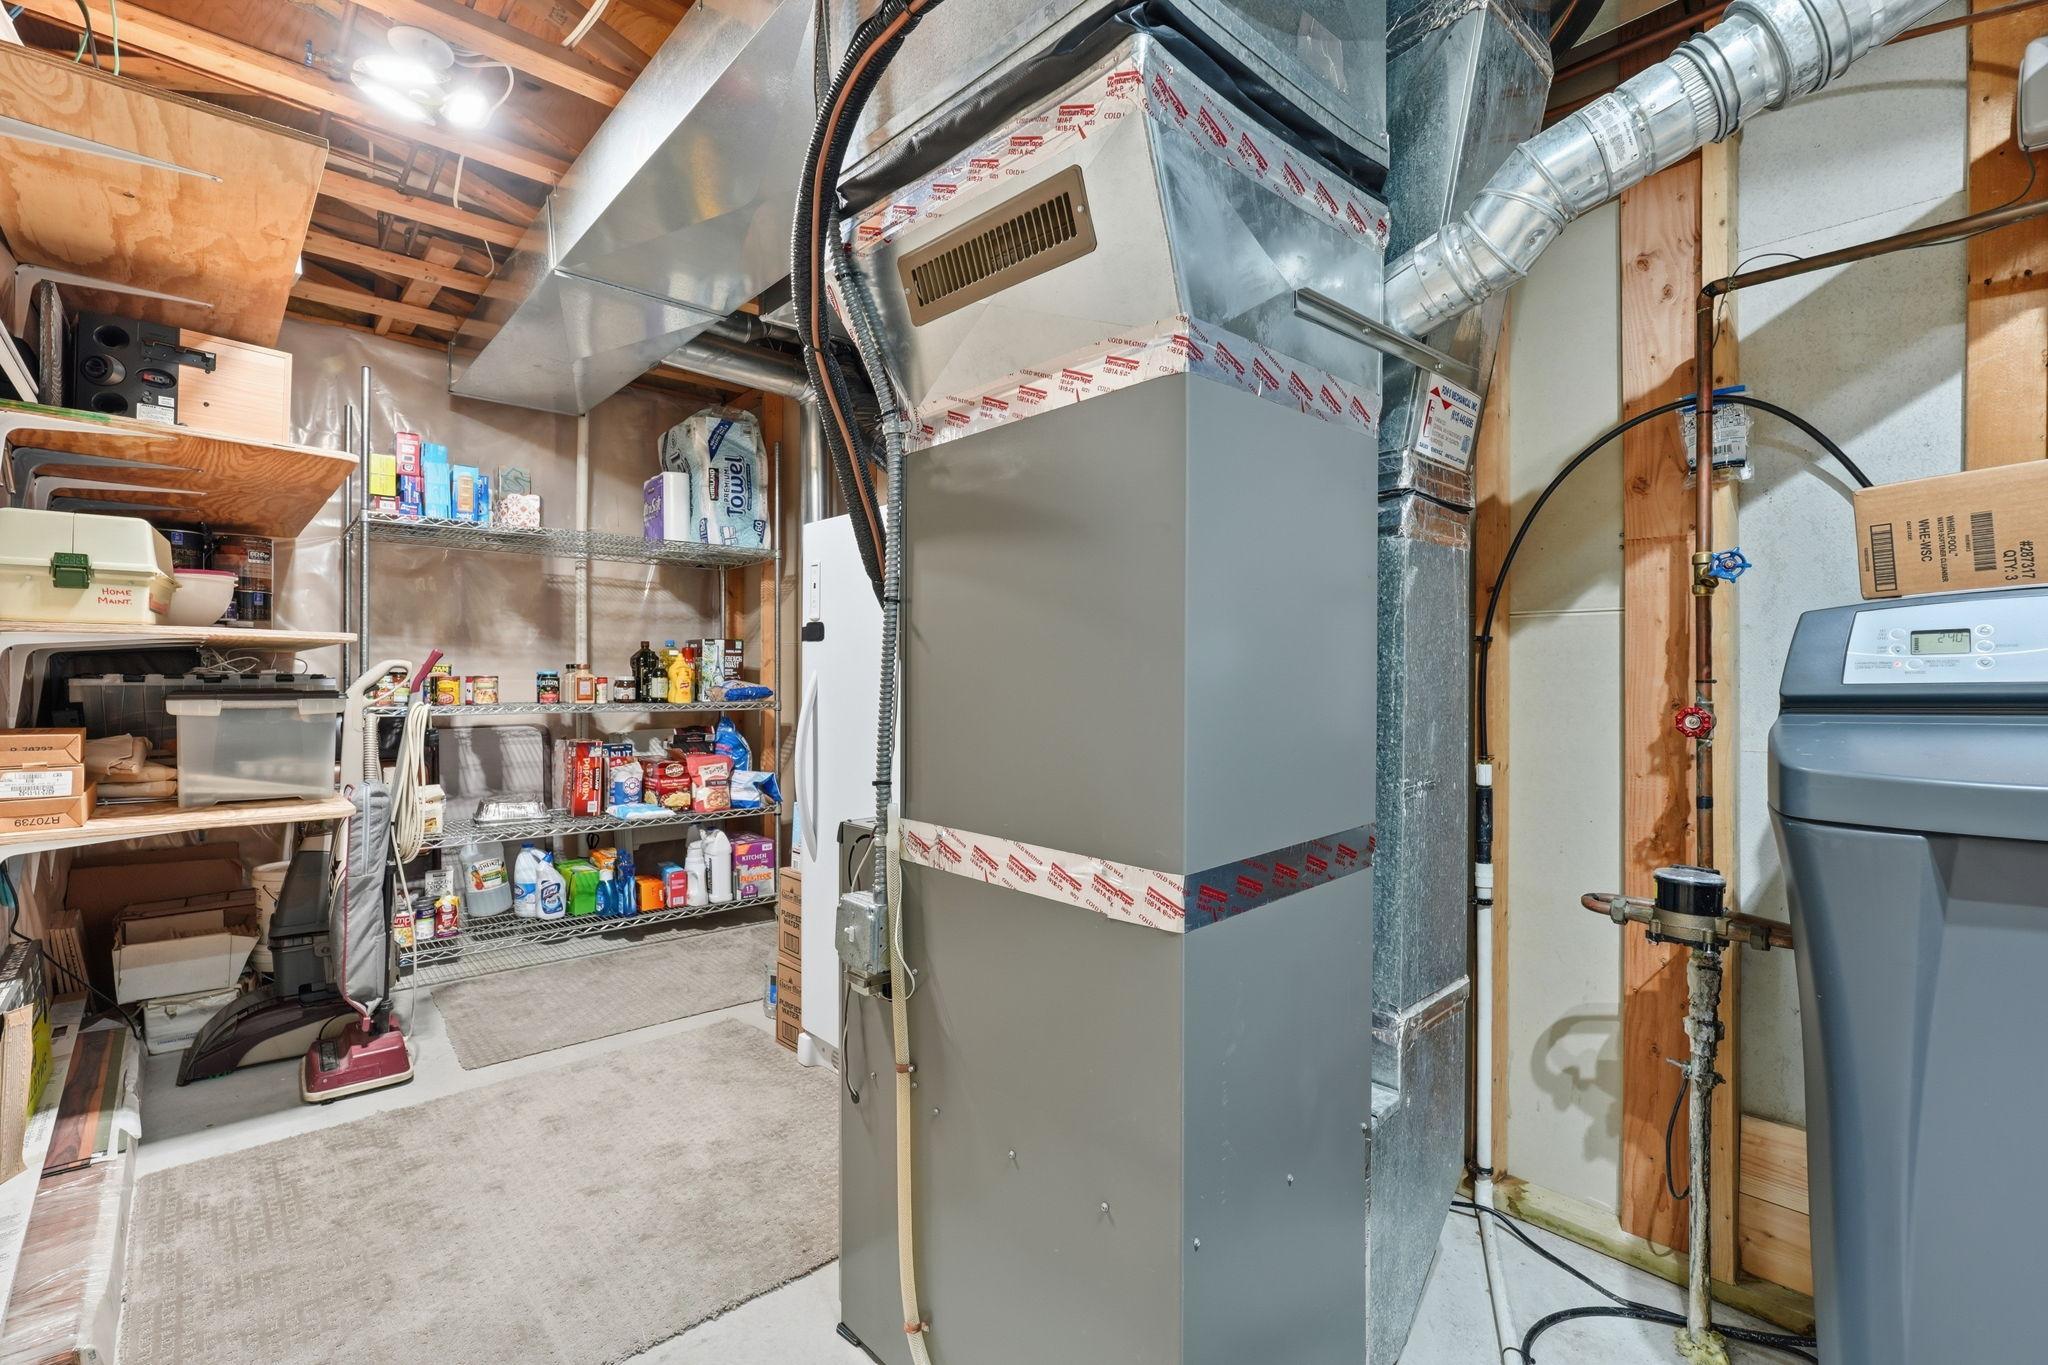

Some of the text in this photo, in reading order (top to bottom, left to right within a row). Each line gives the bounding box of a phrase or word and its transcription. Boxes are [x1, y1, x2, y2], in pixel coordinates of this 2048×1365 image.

[725, 455, 745, 517] Towel
[1918, 518, 1933, 562] WHE-WSC
[2003, 549, 2018, 573] QTY:
[2019, 540, 2036, 579] #287317
[582, 757, 591, 801] POPCORN
[741, 853, 767, 861] KITCHEN
[1152, 871, 1168, 883] COLD
[780, 909, 802, 921] PURIFIE
[779, 998, 802, 1014] PURIFIE
